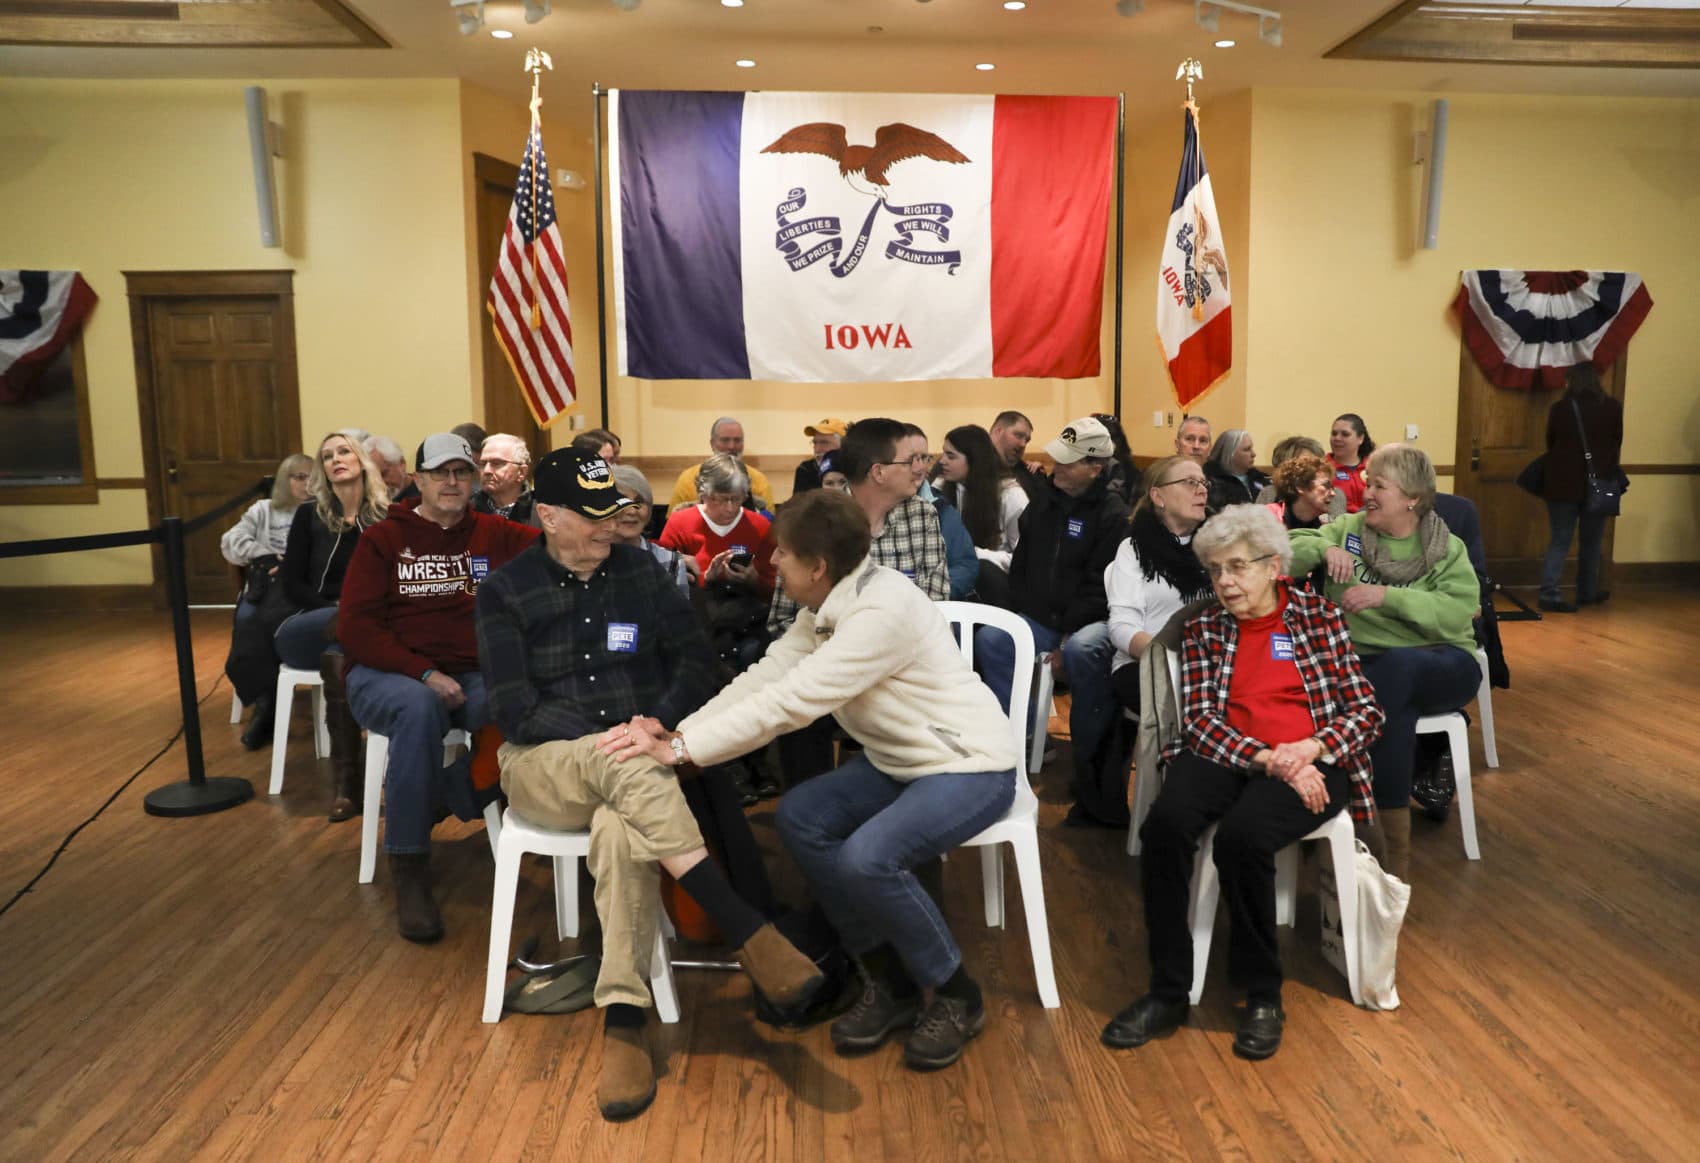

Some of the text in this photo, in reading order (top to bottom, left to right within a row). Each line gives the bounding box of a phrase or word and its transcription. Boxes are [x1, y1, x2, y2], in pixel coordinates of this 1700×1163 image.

[779, 202, 800, 214] OUR
[903, 205, 942, 215] RIGHTS
[779, 220, 831, 241] LIBERTIES
[902, 221, 943, 235] WE WILL
[792, 243, 834, 270] WE PRIZE
[842, 234, 868, 275] AND OUR
[896, 249, 945, 263] MAINTAIN
[1162, 266, 1184, 307] IOWA
[824, 323, 912, 350] IOWA
[400, 581, 464, 594] CHAMPIONSHIPS
